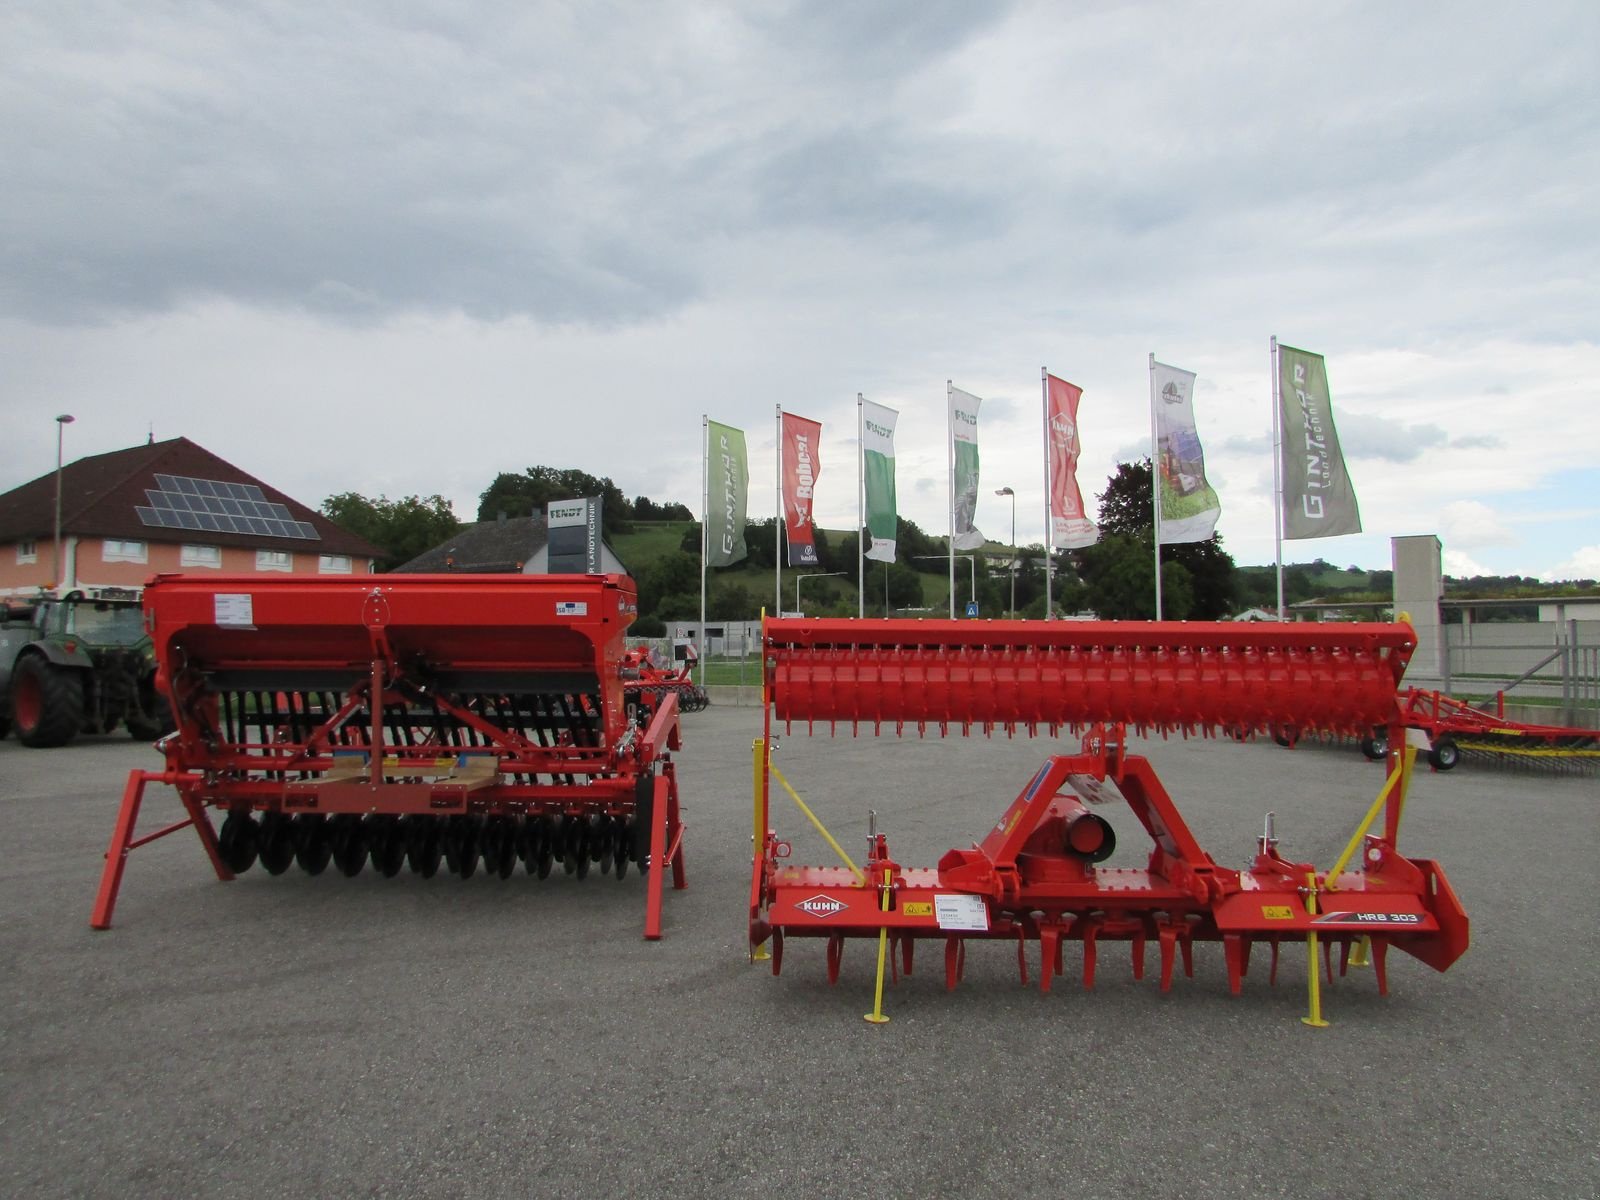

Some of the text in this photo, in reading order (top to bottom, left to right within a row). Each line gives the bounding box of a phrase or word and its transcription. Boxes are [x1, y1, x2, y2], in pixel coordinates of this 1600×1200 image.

[550, 507, 583, 519] FENDT
[588, 502, 596, 565] LANDTECHNIK
[803, 902, 840, 911] KUHN
[1357, 913, 1387, 921] HRB
